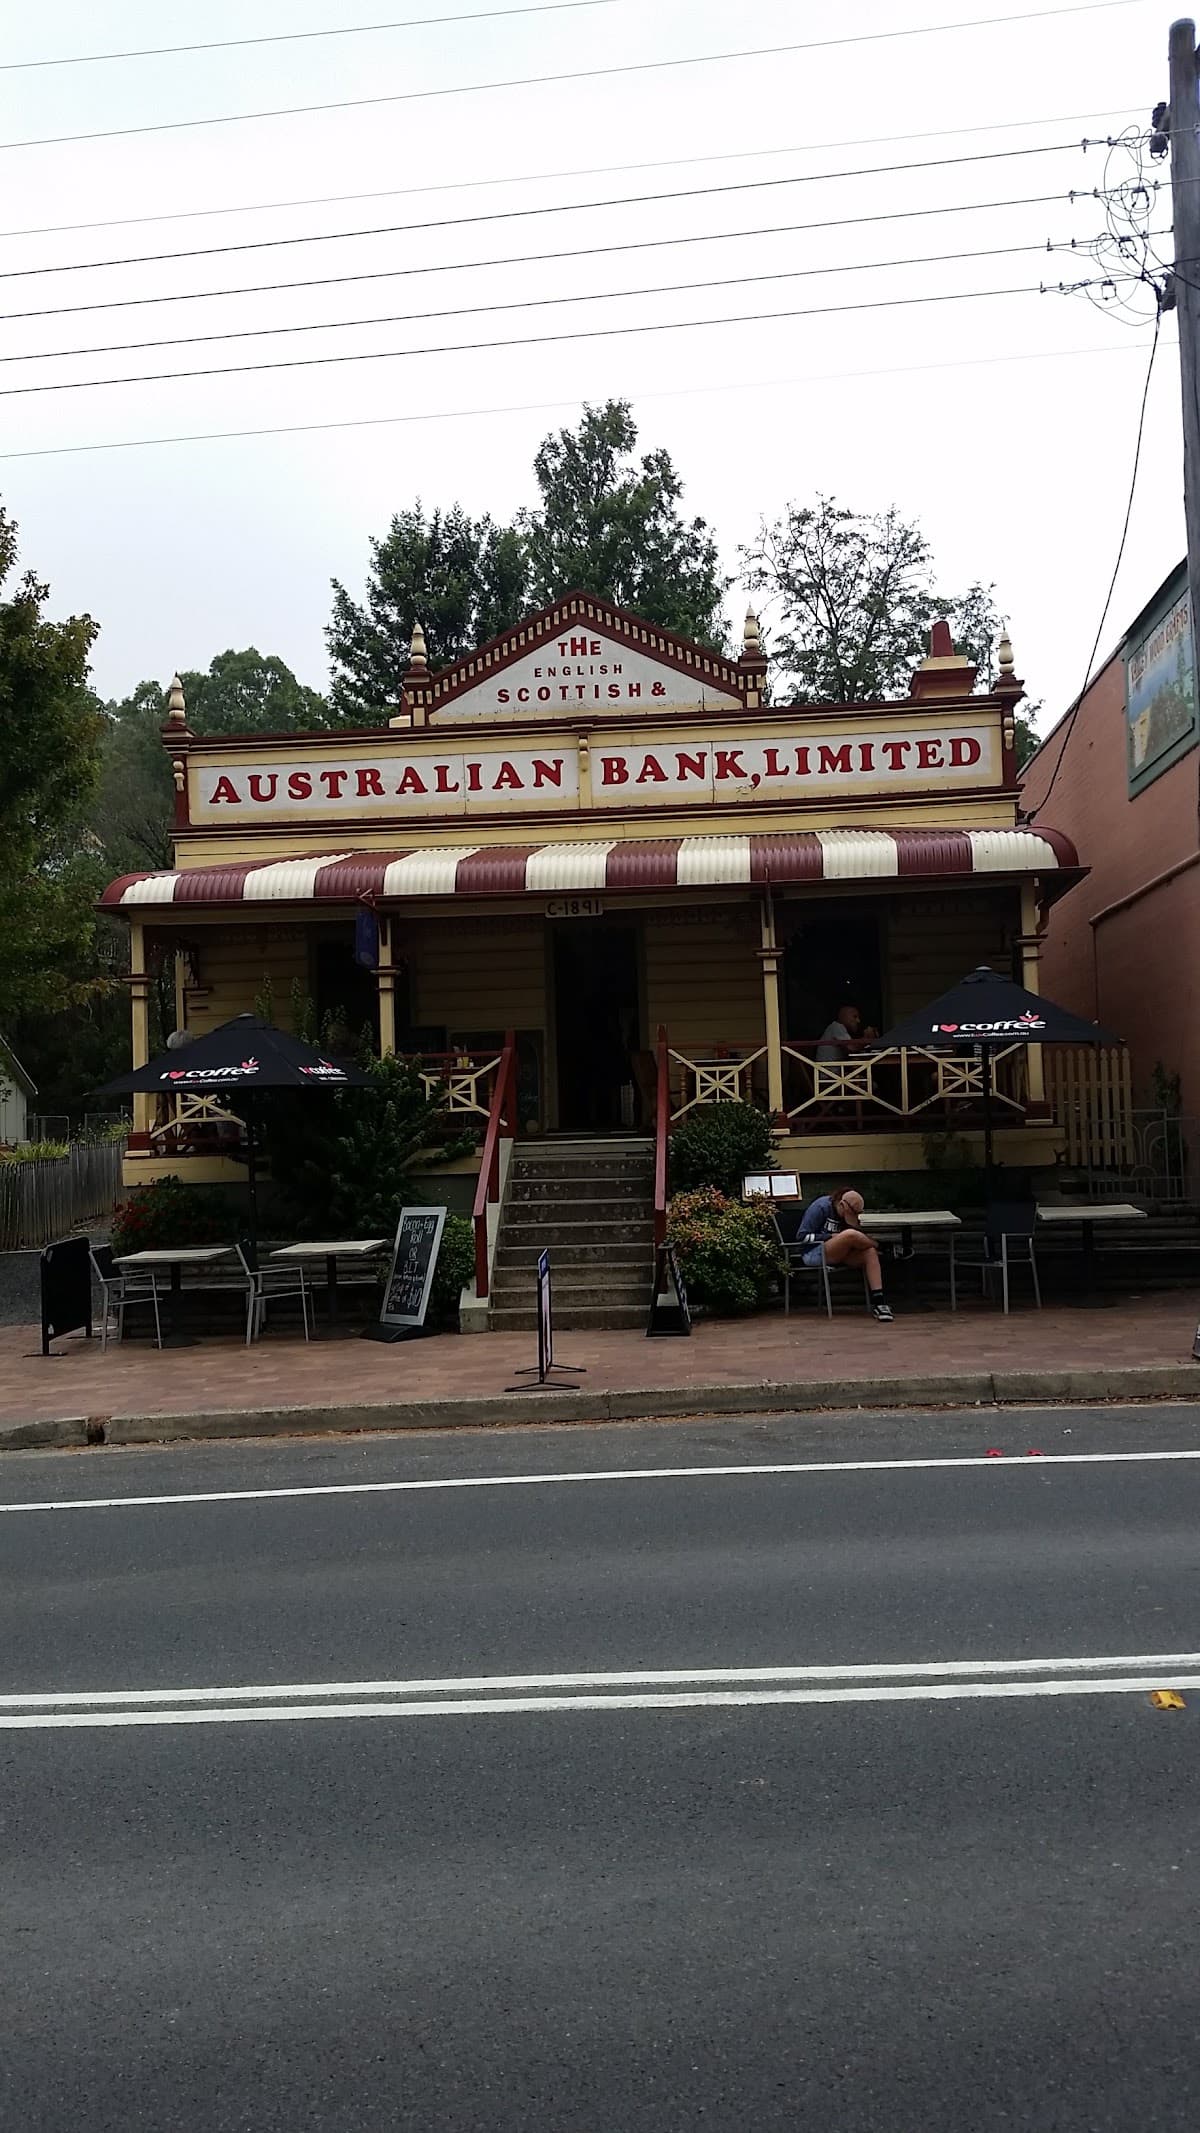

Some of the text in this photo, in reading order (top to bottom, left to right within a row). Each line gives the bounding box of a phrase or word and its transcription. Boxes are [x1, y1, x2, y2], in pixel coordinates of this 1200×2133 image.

[557, 636, 602, 657] THE
[534, 663, 623, 678] ENGLISH
[497, 681, 667, 704] SCOTTISH &
[209, 758, 564, 804] AUSTRALIAN
[960, 1020, 1046, 1031] coffee
[185, 1067, 259, 1077] coffee
